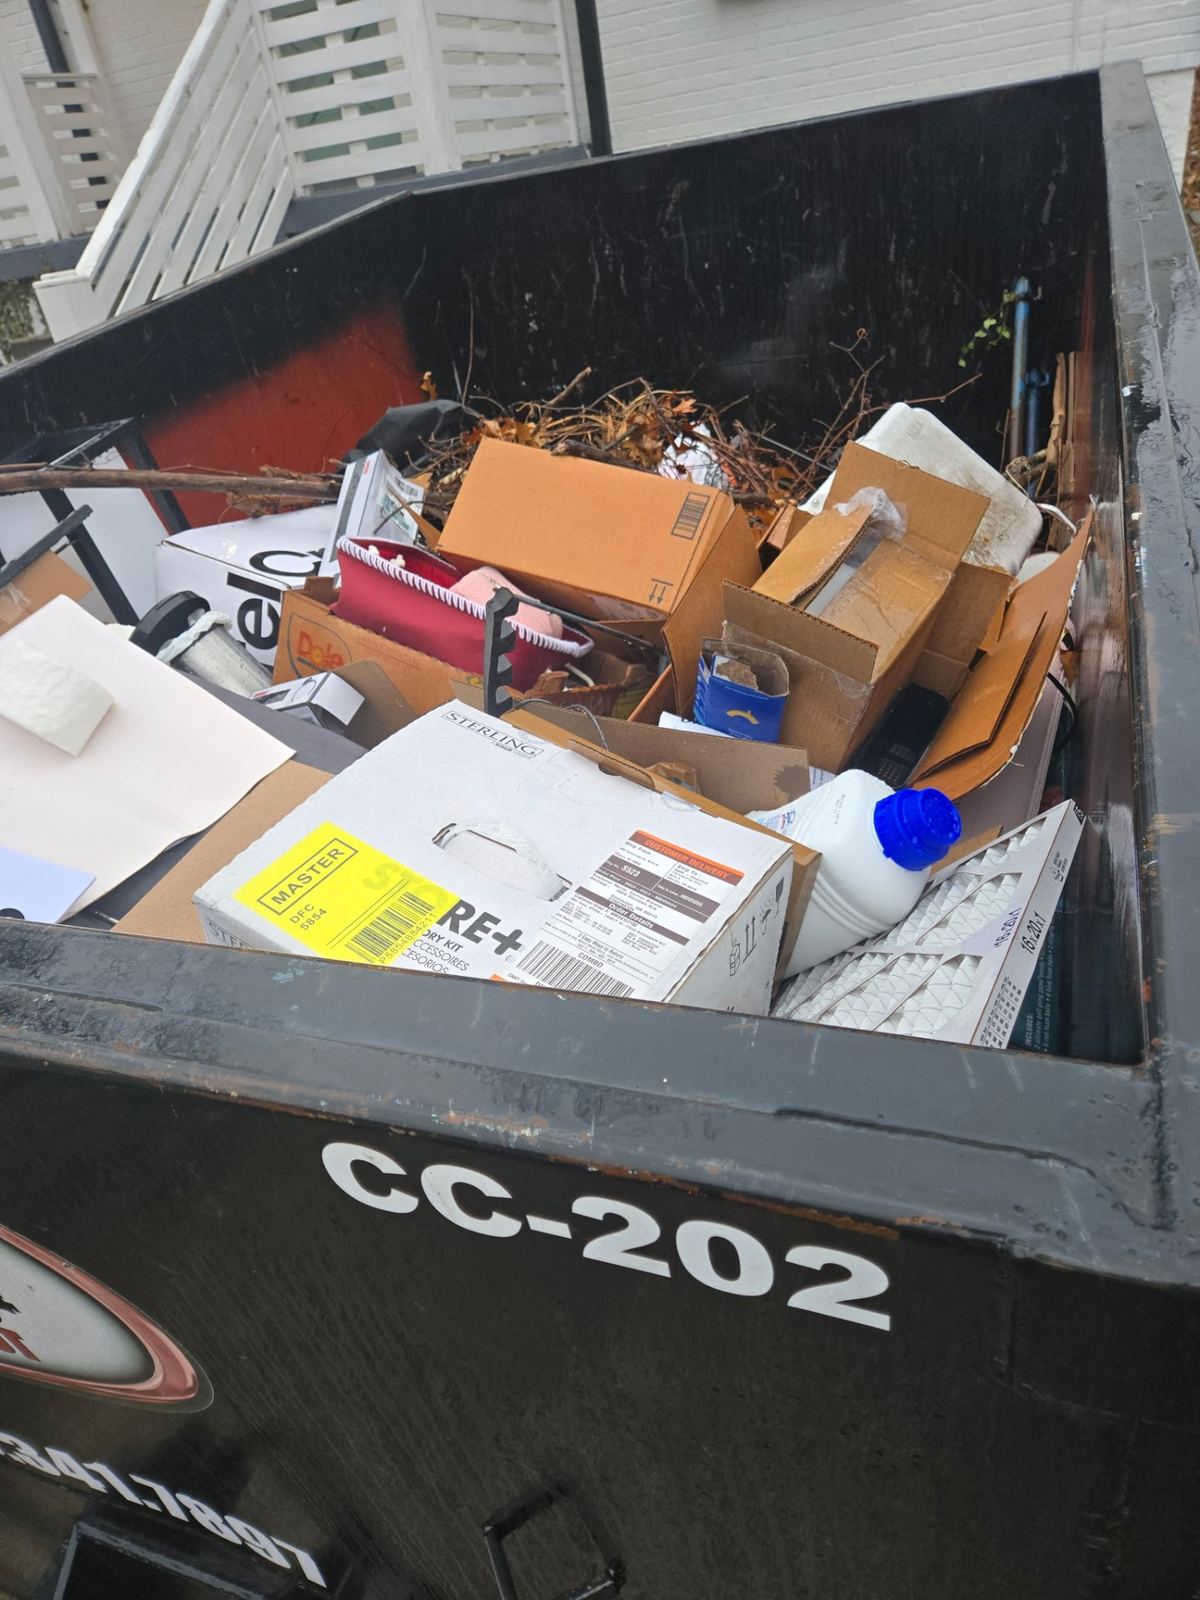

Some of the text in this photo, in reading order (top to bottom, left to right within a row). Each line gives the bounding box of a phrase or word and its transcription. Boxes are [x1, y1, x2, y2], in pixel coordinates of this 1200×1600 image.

[446, 713, 537, 755] STERLING
[271, 847, 345, 906] MASTER
[644, 840, 690, 862] CUSTOMER
[688, 859, 731, 880] DELIVERY
[289, 904, 314, 924] DFC
[300, 908, 327, 930] 5854
[608, 903, 629, 917] Order
[629, 913, 655, 929] Details
[444, 938, 464, 951] KIT
[1020, 910, 1047, 955] 16x20x1
[578, 952, 603, 968] COMBO
[322, 1142, 892, 1331] CC-202
